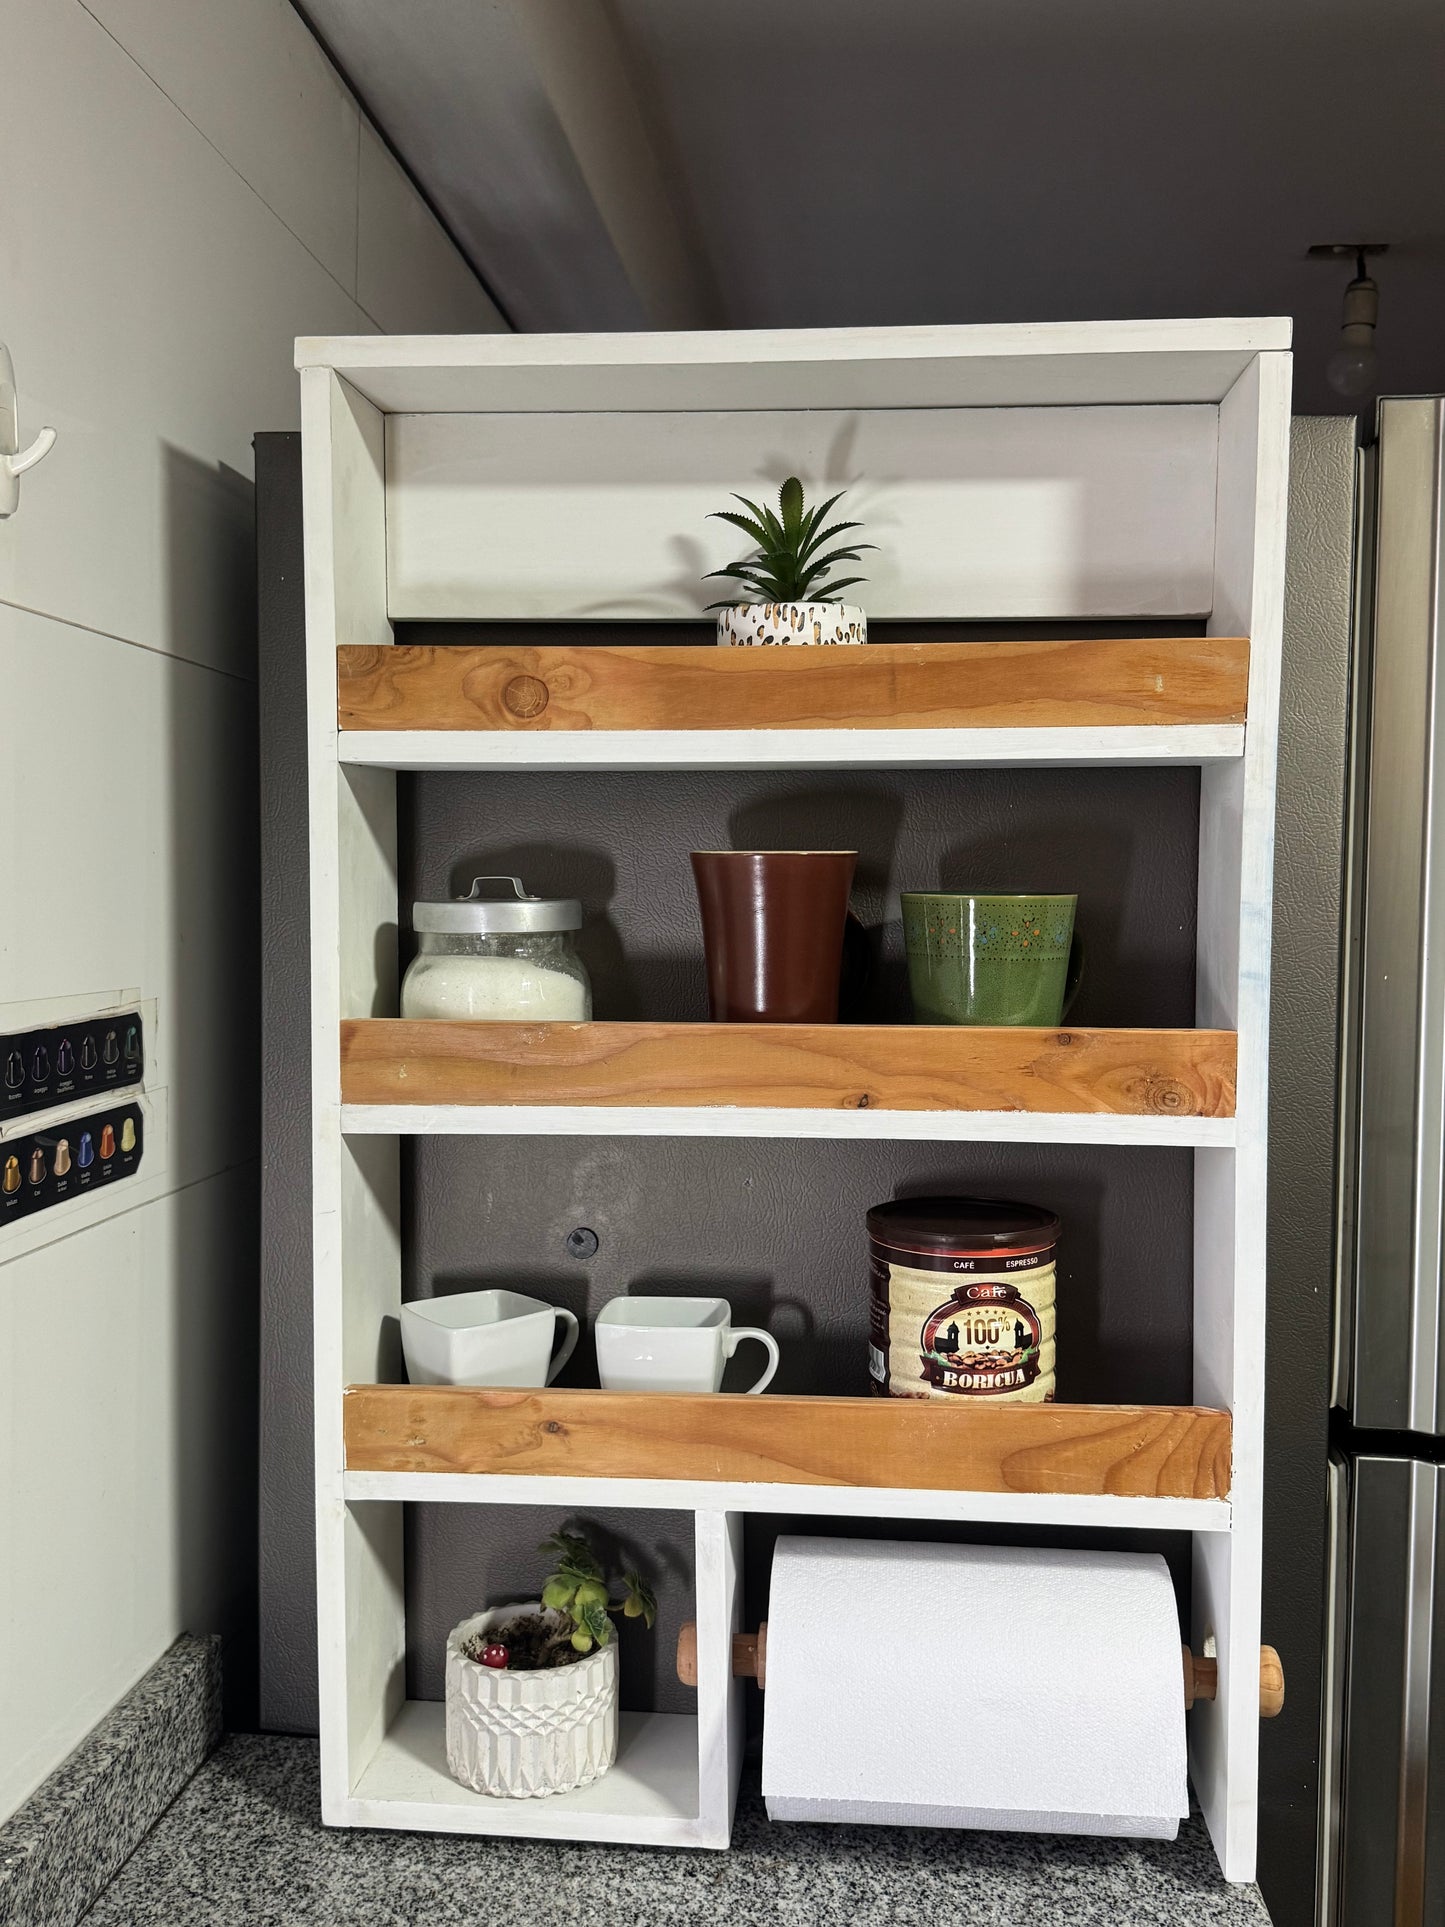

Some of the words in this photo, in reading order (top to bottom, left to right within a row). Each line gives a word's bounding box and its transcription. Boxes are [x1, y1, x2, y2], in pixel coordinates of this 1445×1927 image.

[953, 1261, 975, 1270] CAFÉ
[1006, 1256, 1038, 1268] ESPRESSO
[966, 1285, 1007, 1299] Café
[963, 1316, 1011, 1345] 100%
[943, 1368, 1026, 1389] BORICUA
